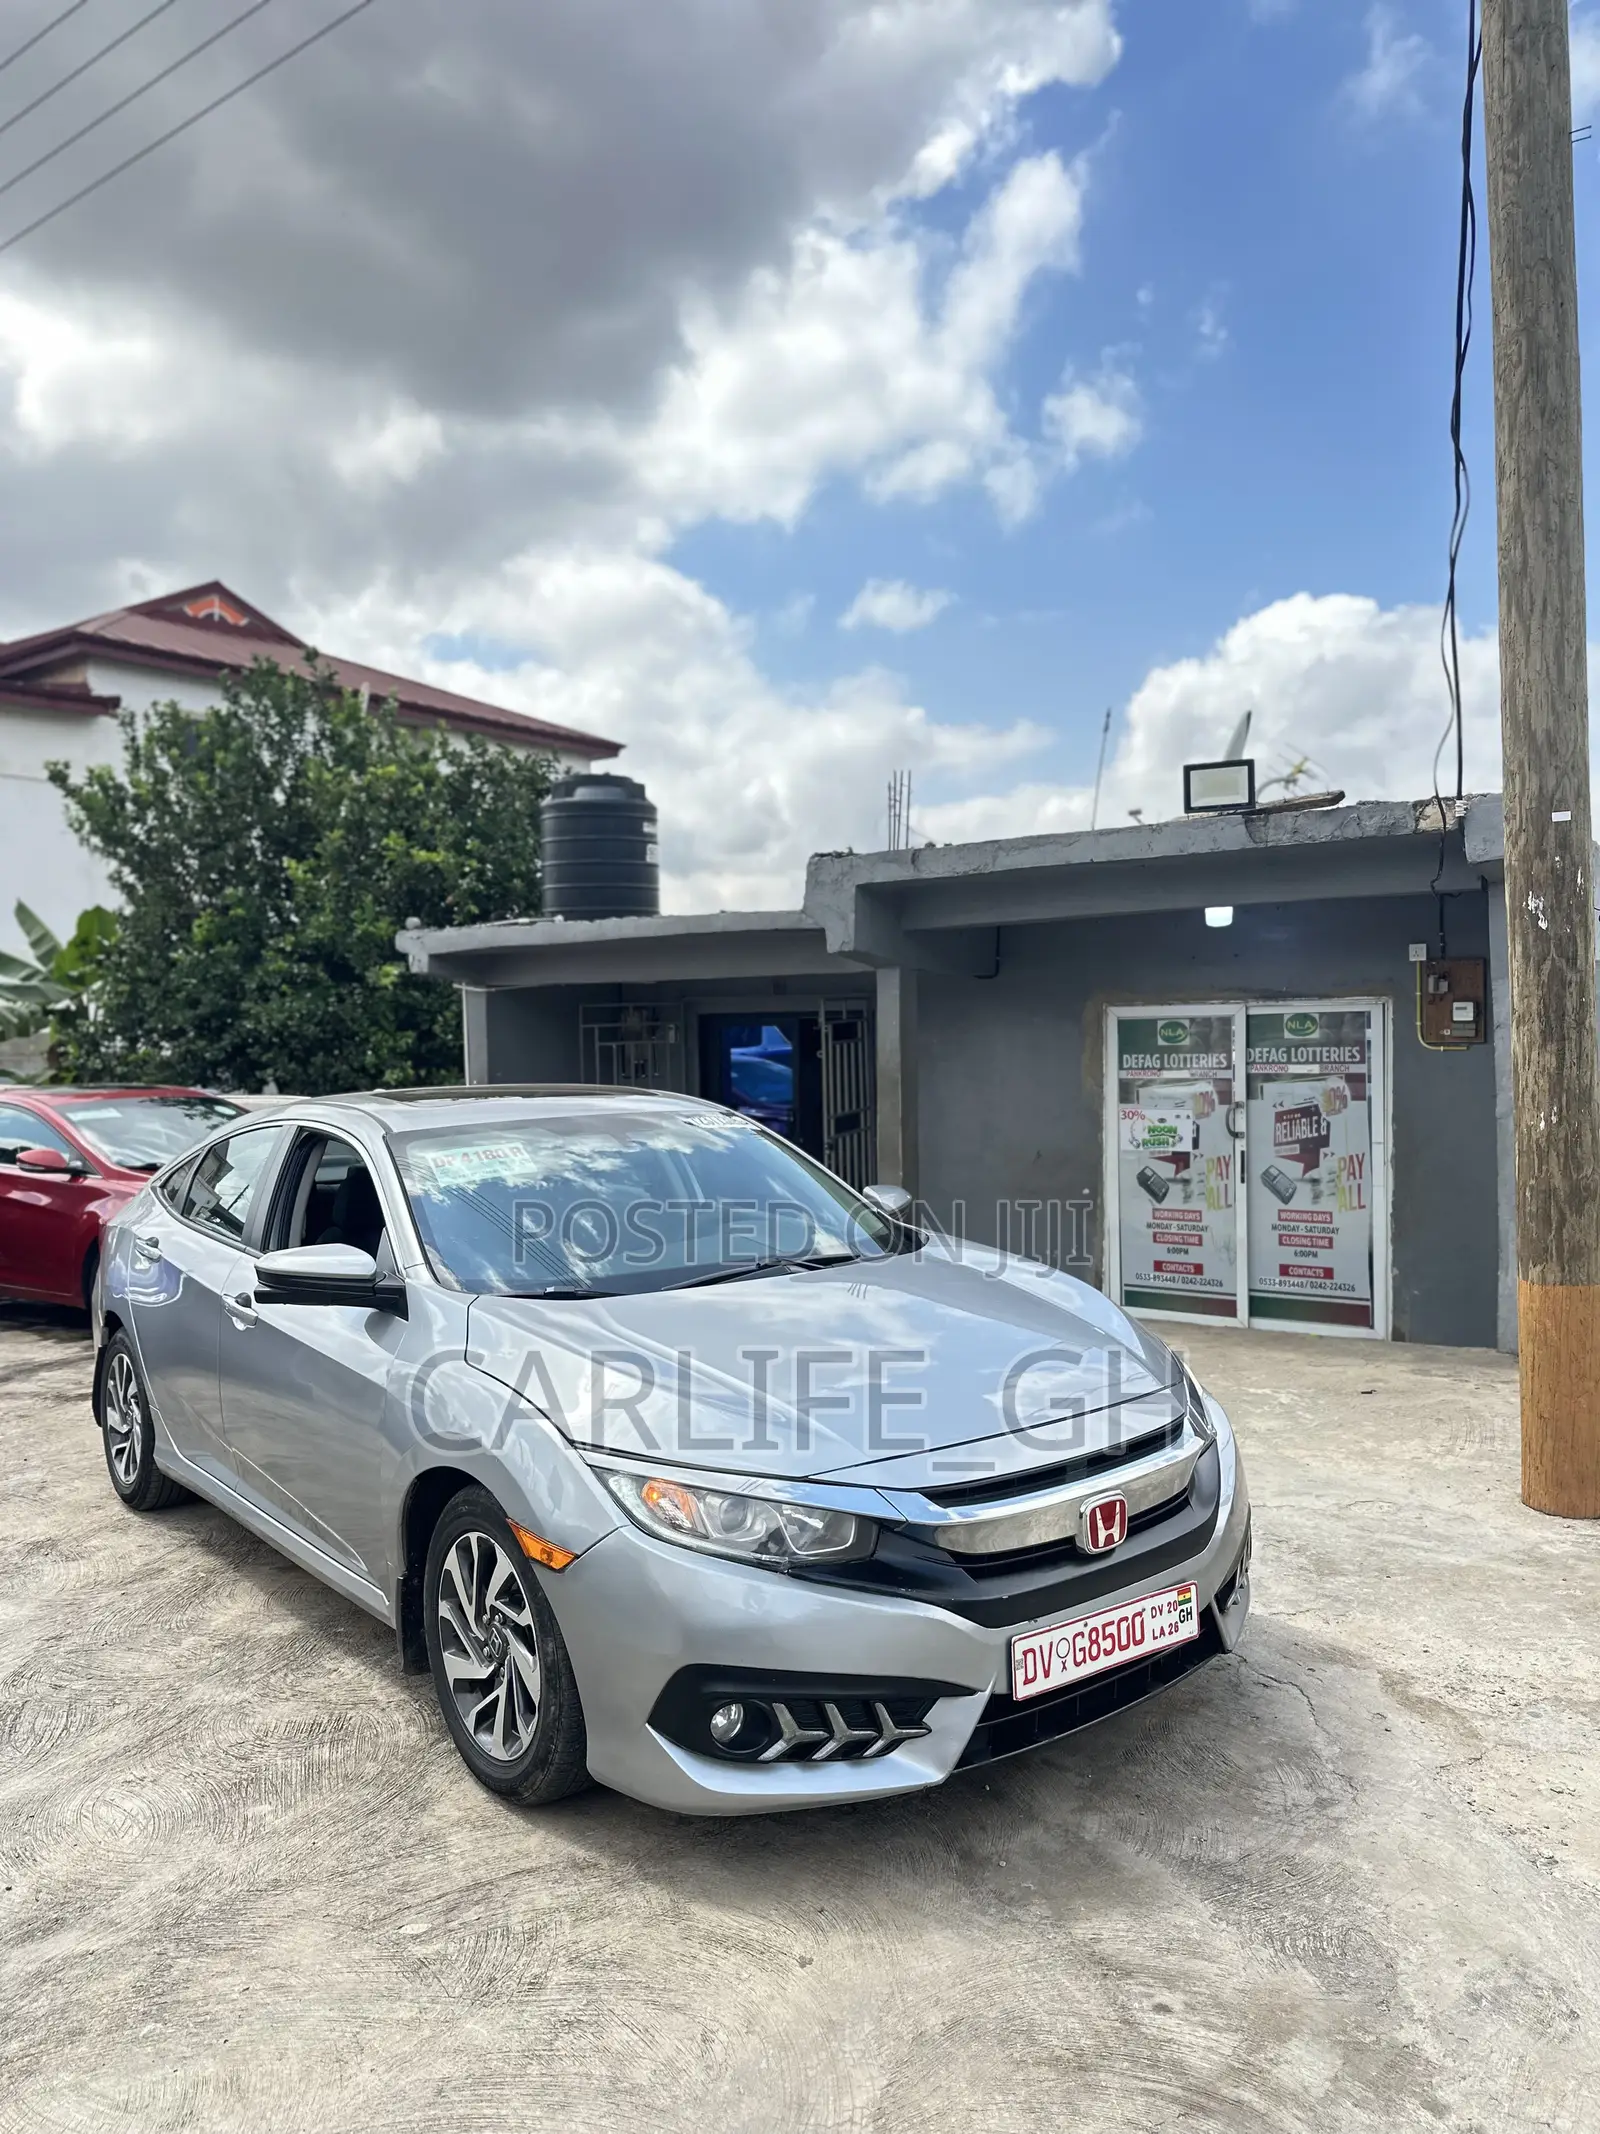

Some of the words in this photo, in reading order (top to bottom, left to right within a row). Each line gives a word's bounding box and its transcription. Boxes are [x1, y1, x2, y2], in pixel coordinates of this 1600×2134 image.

[1286, 1019, 1314, 1031] NLA
[1160, 1028, 1185, 1037] NLA
[1247, 1047, 1287, 1063] DEFAG
[1291, 1045, 1361, 1062] LOTTERIES
[1122, 1053, 1161, 1069] DEFAG
[1163, 1052, 1228, 1069] LOTTERIES
[1120, 1109, 1146, 1121] 30%
[1147, 1125, 1178, 1135] NOON
[1275, 1115, 1319, 1144] RELIABLE
[1320, 1115, 1328, 1136] &
[1142, 1136, 1170, 1148] RUSH
[1206, 1153, 1232, 1184] PAY
[1337, 1152, 1365, 1183] PAY
[1338, 1183, 1366, 1213] ALL
[1154, 1210, 1184, 1220] WORKING
[1184, 1211, 1201, 1221] DAYS
[1279, 1211, 1312, 1222] WORKING
[1313, 1212, 1331, 1223] DAYS
[1146, 1222, 1172, 1231] MONDAY
[1176, 1223, 1209, 1232] SATURDAY
[1271, 1223, 1300, 1233] MONDAY
[1304, 1225, 1340, 1235] SATURDAY
[1155, 1234, 1184, 1244] CLOSING
[1185, 1235, 1200, 1245] TIME
[1281, 1235, 1312, 1246] CLOSING
[1312, 1238, 1330, 1248] TIME
[1293, 1249, 1319, 1258] 6:00PM
[1162, 1262, 1195, 1274] CONTACTS
[1288, 1266, 1324, 1278] CONTACTS
[1309, 1280, 1356, 1293] 0242-224326
[1150, 1604, 1165, 1619] DV
[1166, 1600, 1179, 1615] 20
[1178, 1605, 1193, 1624] GH
[1152, 1625, 1166, 1641] LA
[1167, 1620, 1180, 1636] 26
[1022, 1640, 1054, 1686] DV
[1072, 1610, 1146, 1668] G8500
